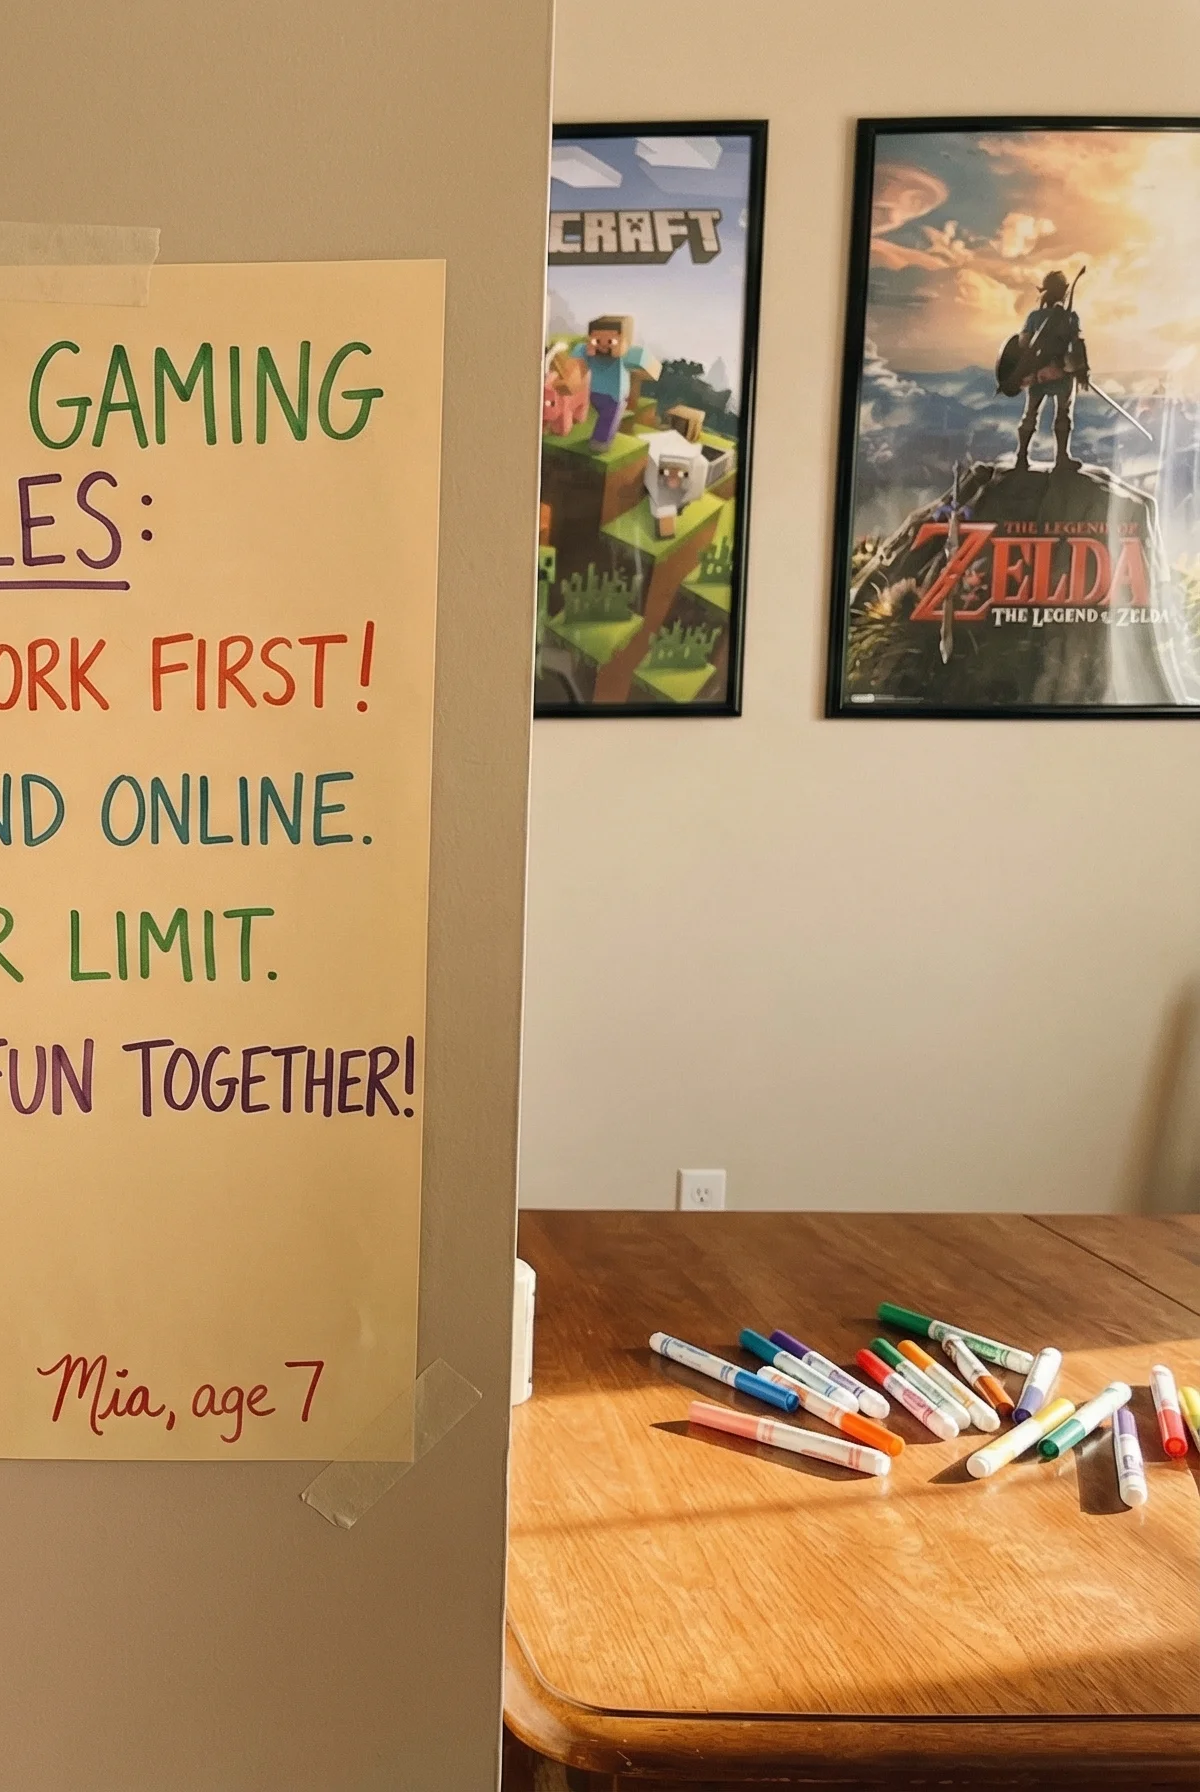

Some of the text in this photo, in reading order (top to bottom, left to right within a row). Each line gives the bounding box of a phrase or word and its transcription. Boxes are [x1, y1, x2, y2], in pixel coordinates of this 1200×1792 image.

[28, 340, 384, 450] GAMING
[909, 522, 1152, 621] ZELDA
[991, 607, 1028, 628] THE
[1032, 607, 1099, 628] LEGEND
[151, 620, 375, 713] FIRST!
[100, 771, 373, 847] ONLINE.
[69, 907, 278, 983] LIMIT.
[121, 1035, 415, 1119] TOGETHER!
[36, 1353, 325, 1445] Mia, age 7
